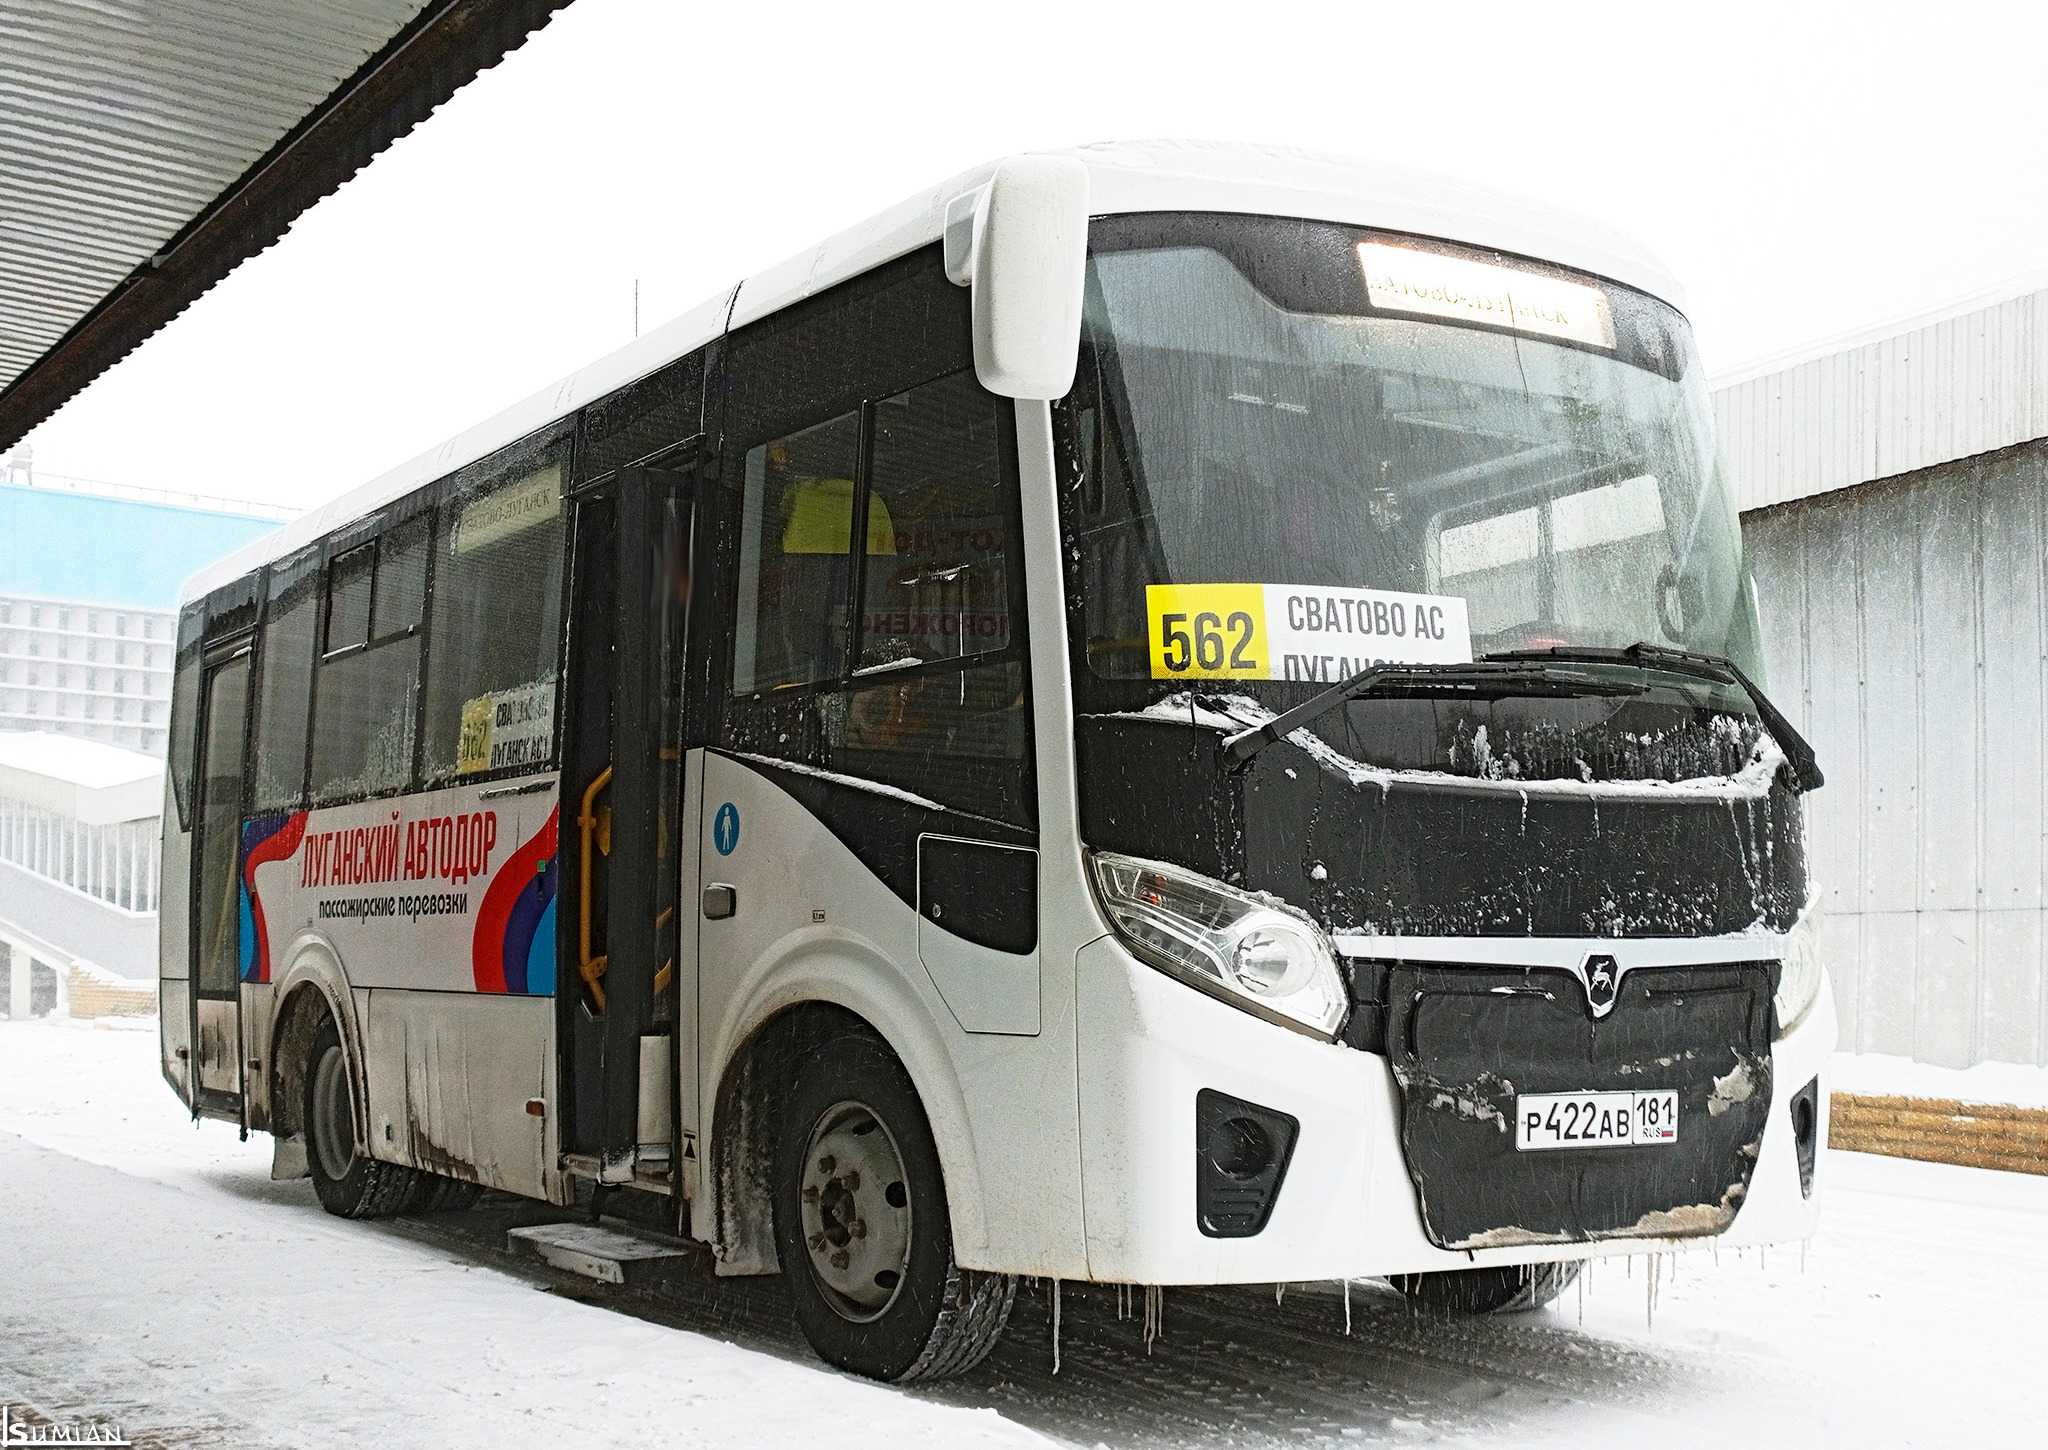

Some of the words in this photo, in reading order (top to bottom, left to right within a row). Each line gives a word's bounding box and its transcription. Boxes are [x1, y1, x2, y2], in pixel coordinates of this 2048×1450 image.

[1287, 595, 1407, 637] СВАТОВО
[1414, 604, 1445, 641] АС
[1162, 611, 1257, 673] 562
[301, 811, 400, 889] ЛУГАНСКИЙ
[403, 810, 497, 886] АВТОДОР
[318, 895, 396, 925] пассажирские
[398, 892, 468, 924] перевозки
[1636, 1096, 1672, 1127] 181
[1642, 1127, 1661, 1138] RUS
